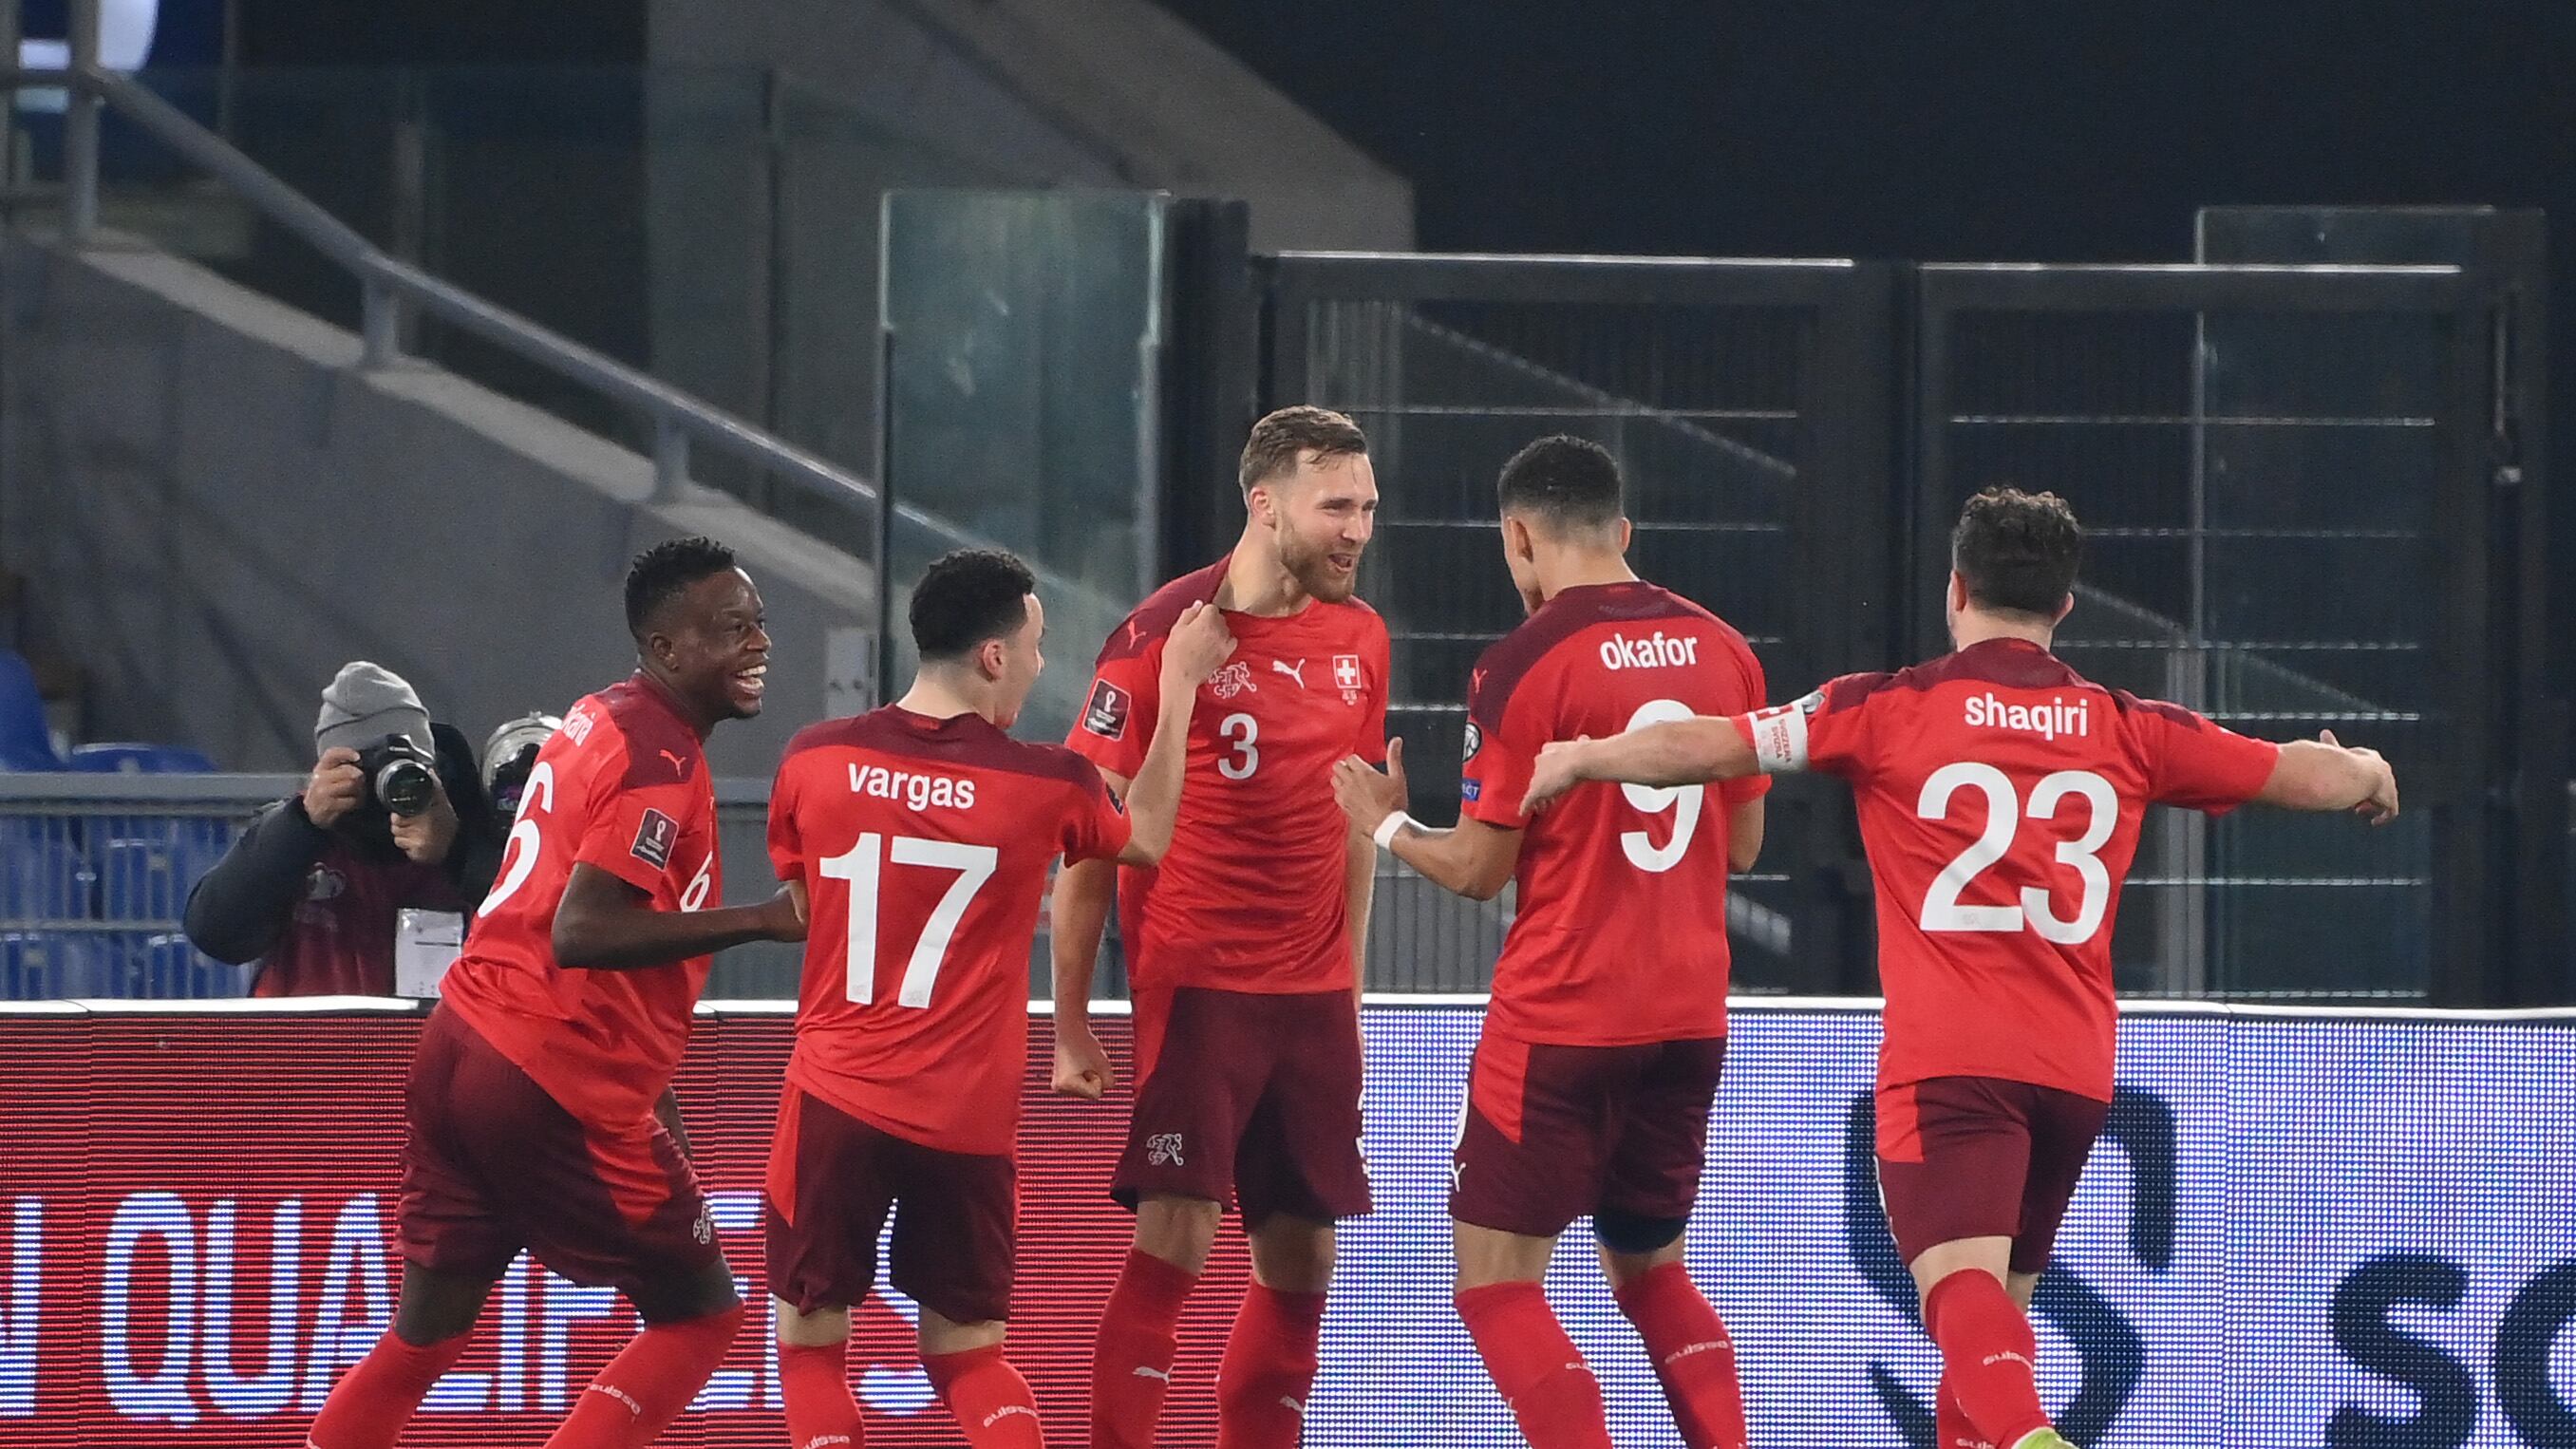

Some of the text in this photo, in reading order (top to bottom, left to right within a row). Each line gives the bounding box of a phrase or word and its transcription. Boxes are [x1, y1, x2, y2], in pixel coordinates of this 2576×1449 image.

[1600, 631, 1699, 670] okafor
[1217, 712, 1259, 780] 3
[1964, 692, 2088, 741] shaqiri
[848, 762, 976, 812] vargas
[680, 851, 714, 913] 6
[1917, 762, 2119, 945] 23
[818, 832, 999, 1009] 17
